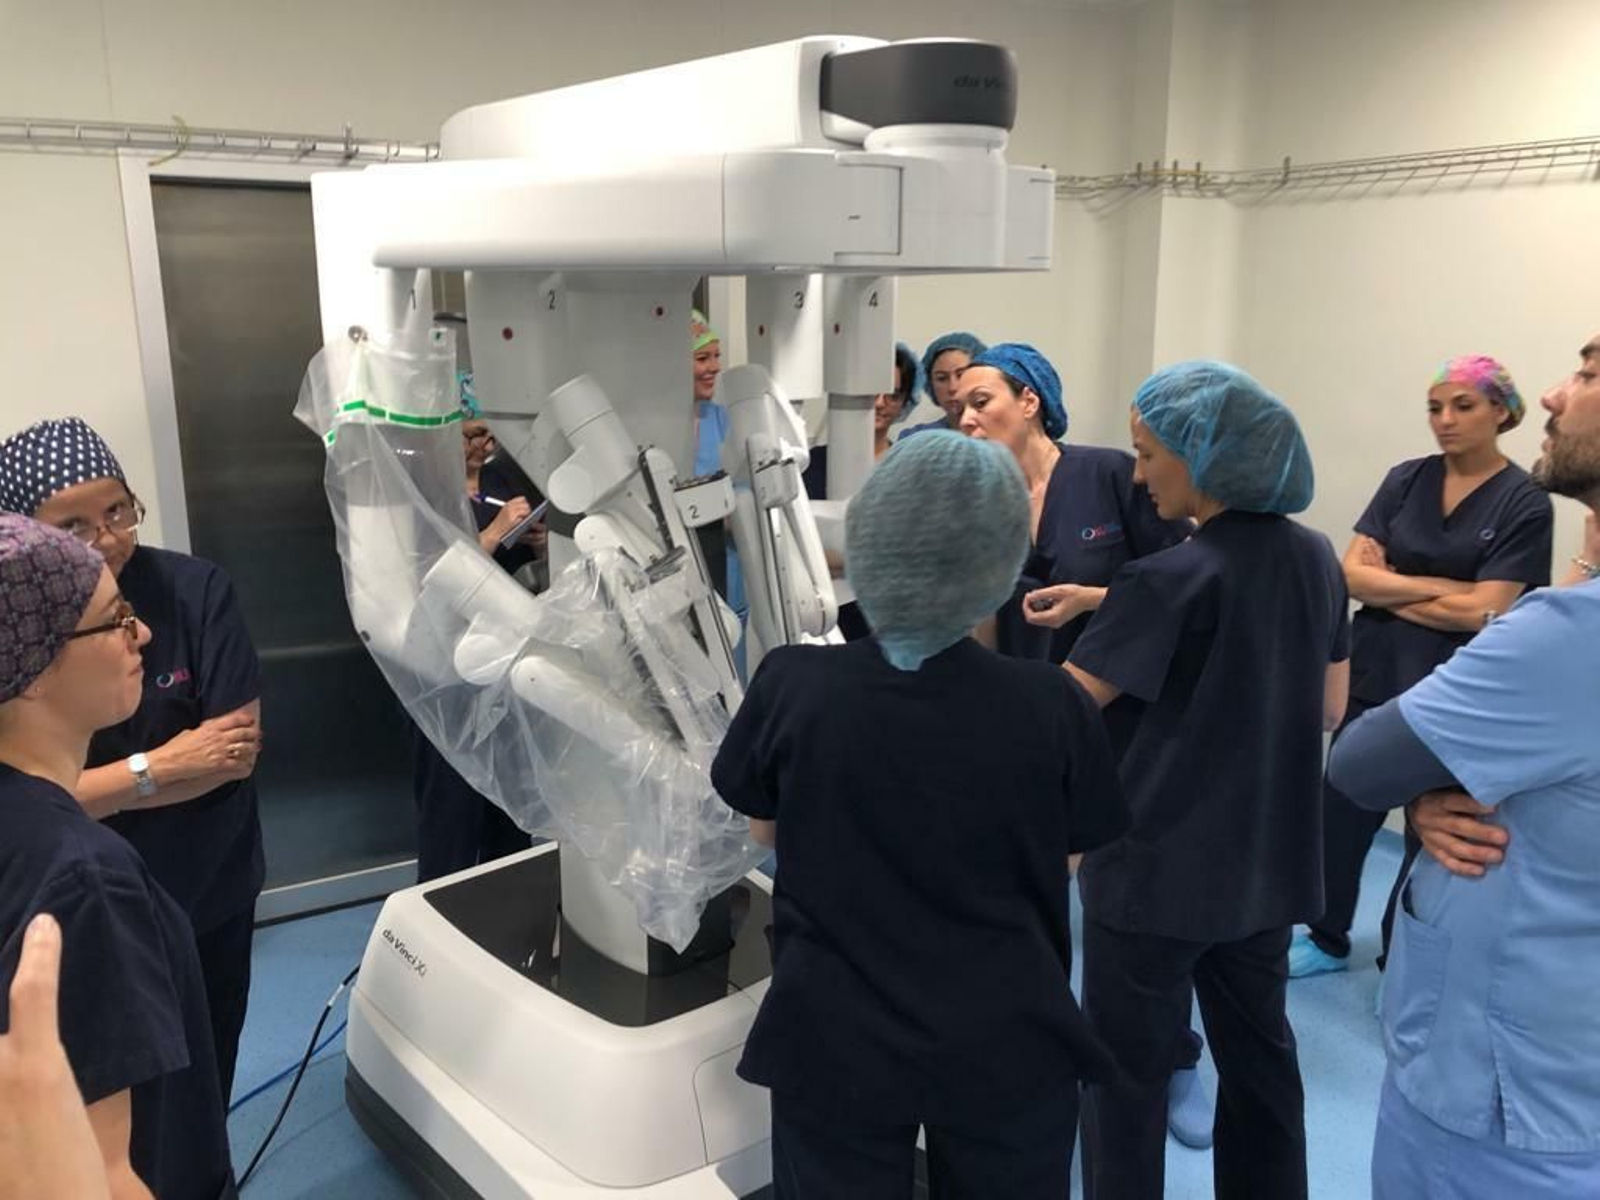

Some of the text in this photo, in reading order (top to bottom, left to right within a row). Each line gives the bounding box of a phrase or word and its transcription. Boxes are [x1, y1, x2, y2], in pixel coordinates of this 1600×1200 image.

[548, 290, 556, 310] 2
[795, 291, 804, 310] 3
[869, 291, 878, 307] 4
[688, 505, 700, 519] 2
[382, 929, 395, 944] da
[394, 938, 418, 965] Vinci
